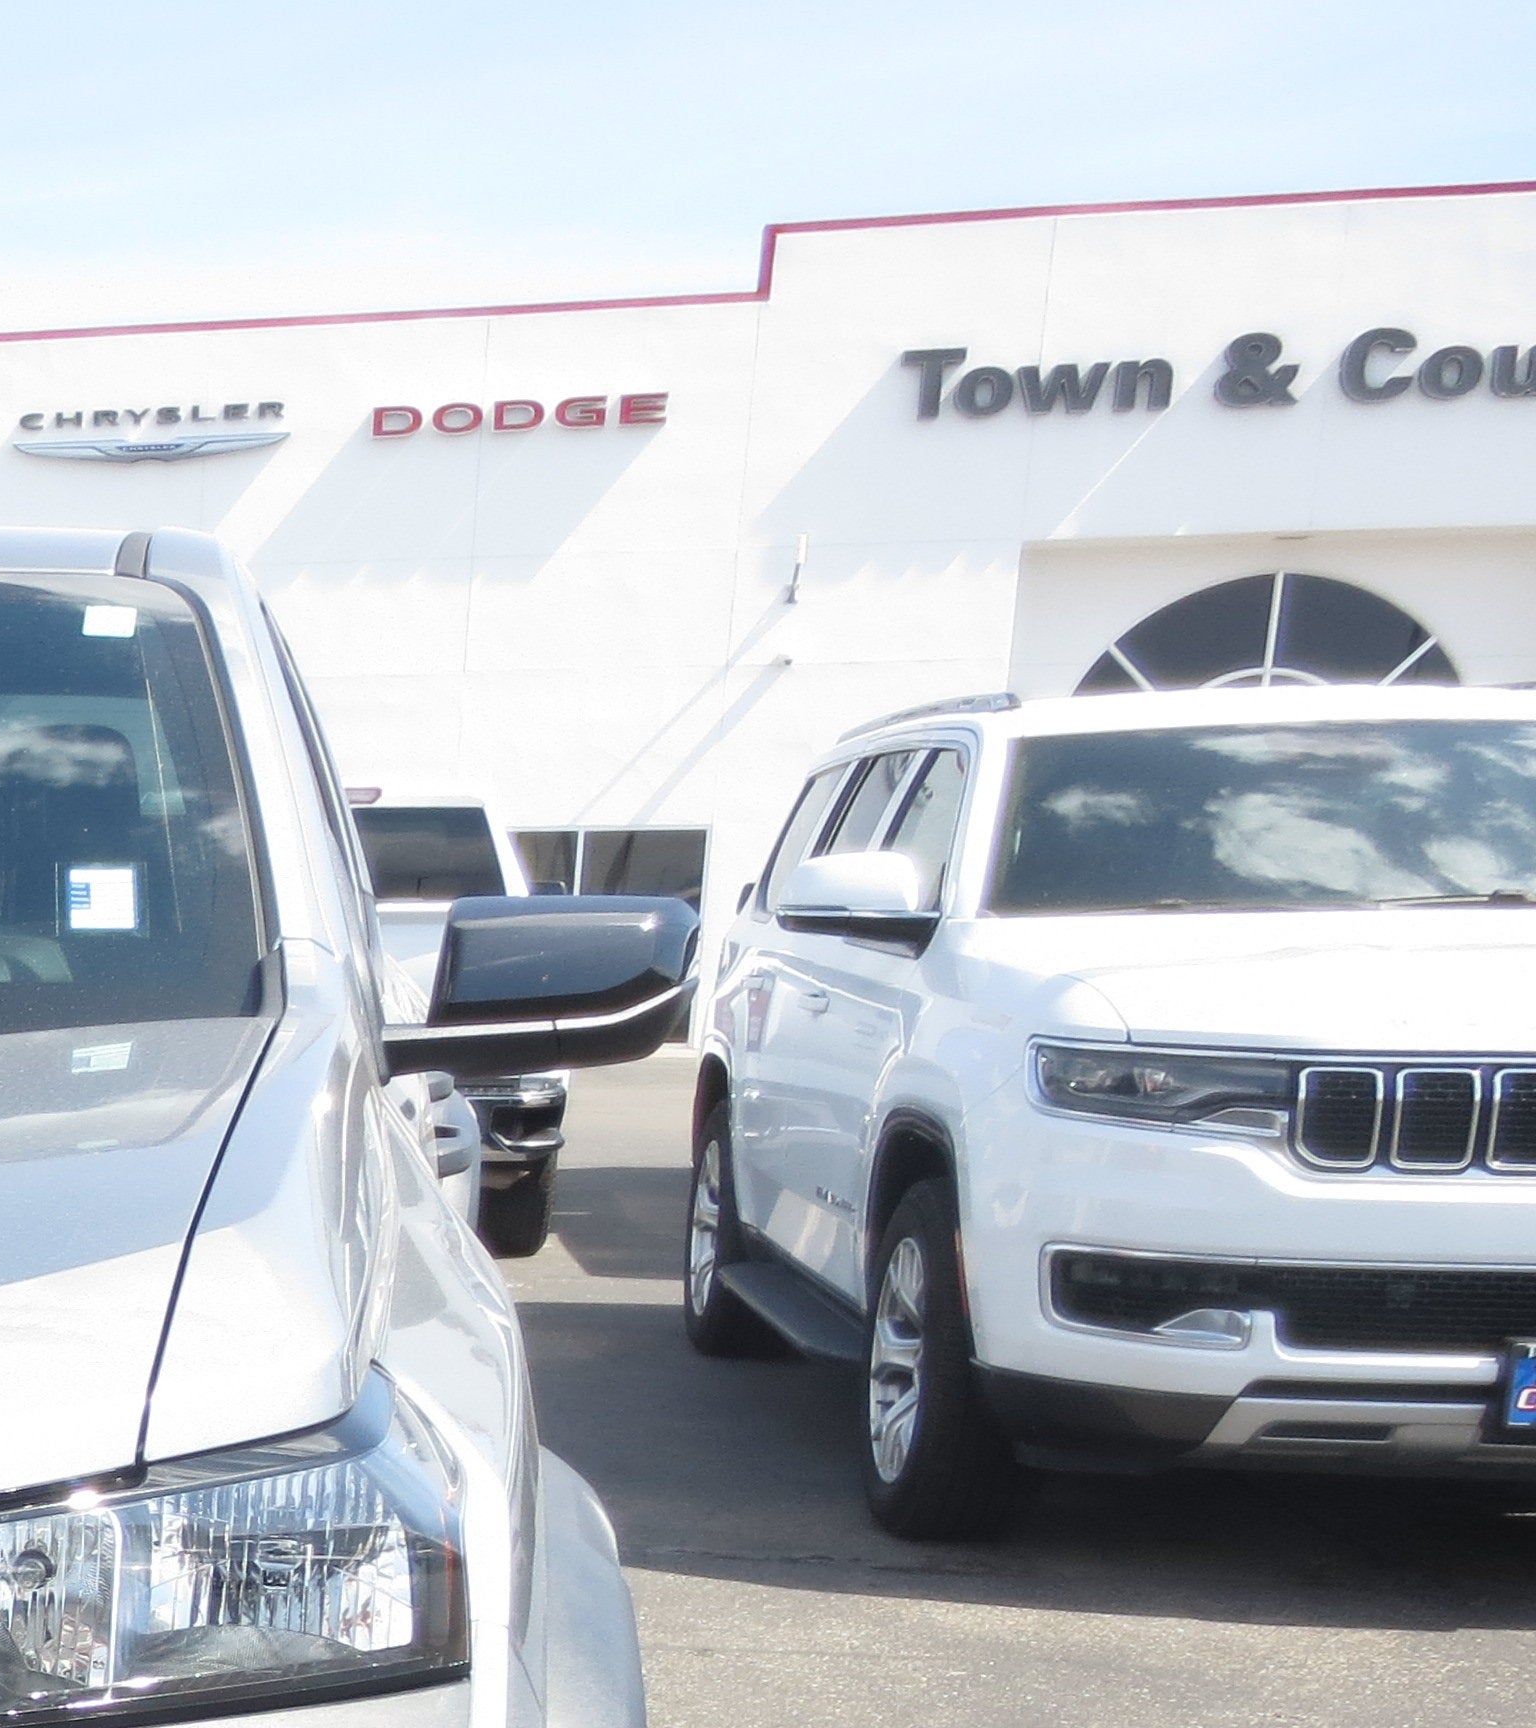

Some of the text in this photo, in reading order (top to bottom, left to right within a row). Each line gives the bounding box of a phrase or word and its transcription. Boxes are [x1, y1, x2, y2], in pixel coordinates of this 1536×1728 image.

[902, 326, 1536, 421] Town & Cou
[19, 401, 286, 431] CHRYSLER
[371, 391, 670, 439] DODGE
